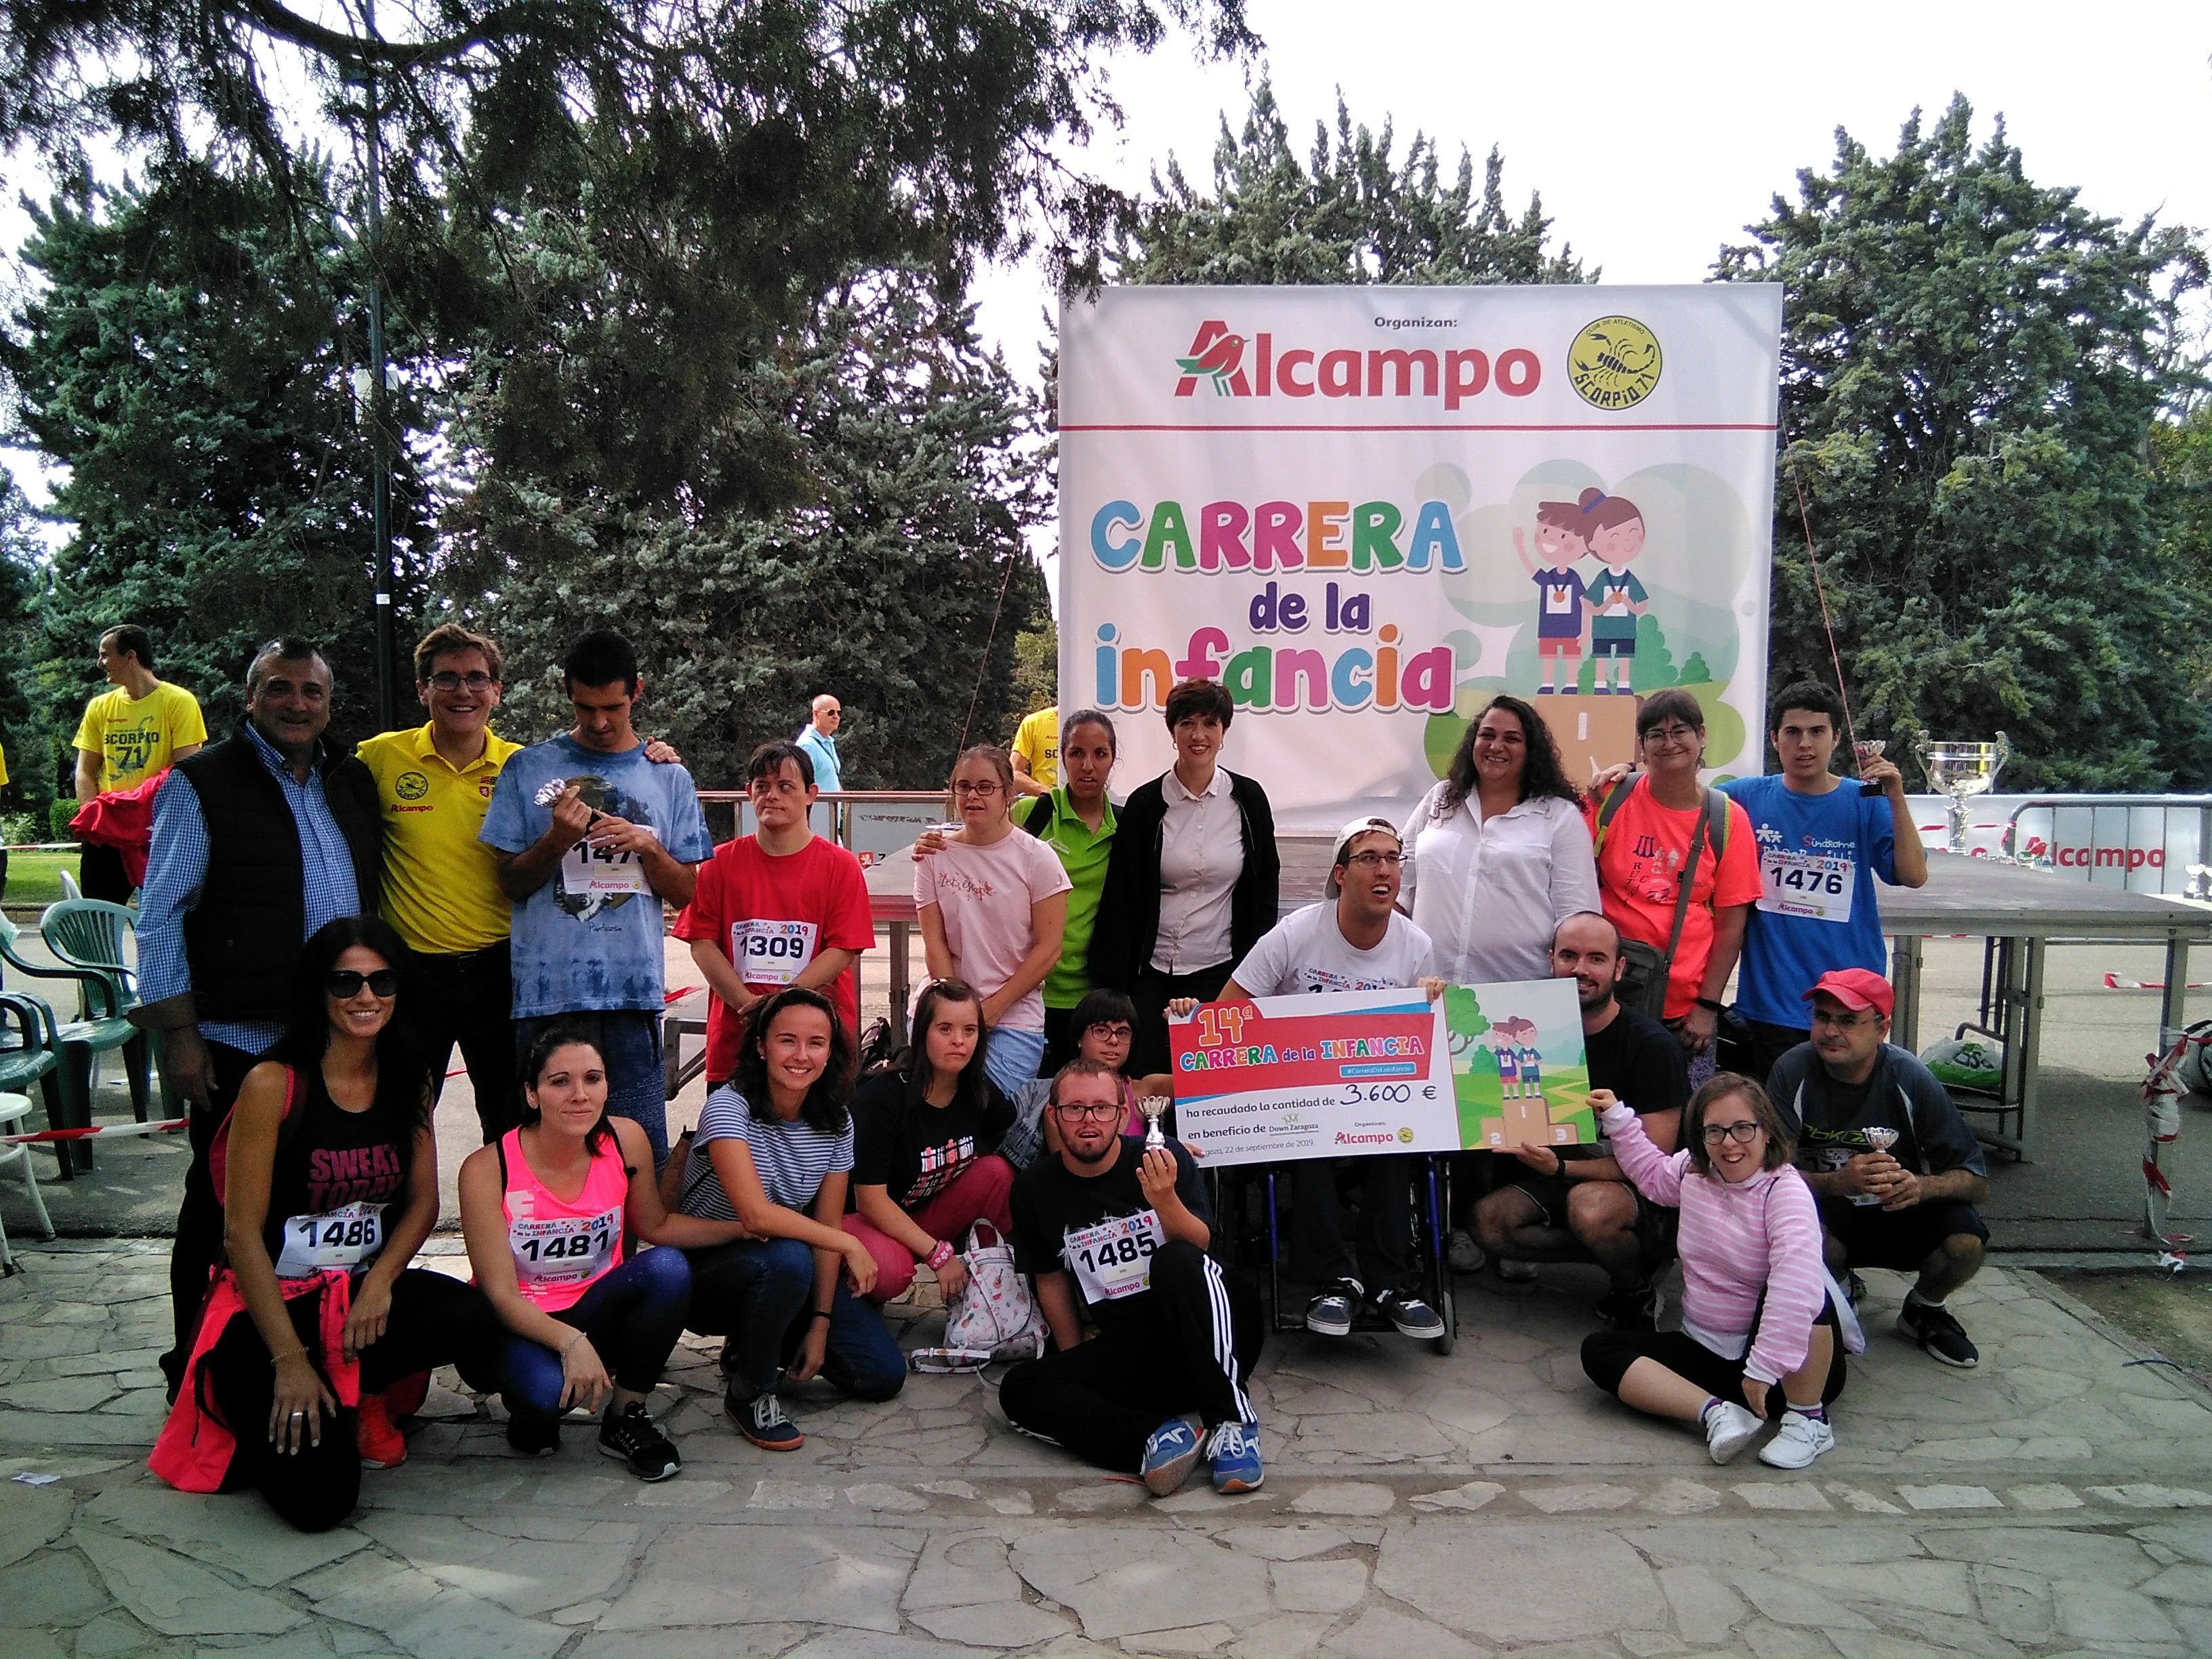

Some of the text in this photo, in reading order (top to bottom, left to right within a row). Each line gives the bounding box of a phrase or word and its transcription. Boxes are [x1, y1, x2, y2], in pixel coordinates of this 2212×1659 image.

[1374, 316, 1458, 330] Organizan:
[1585, 323, 1601, 335] CLUB
[1613, 319, 1645, 335] ATLETISMO
[1174, 320, 1542, 411] Alcampo
[1090, 499, 1467, 574] CARRERA
[1248, 580, 1373, 633] de la
[1093, 622, 1457, 714] infancia
[115, 746, 144, 769] 71
[390, 804, 434, 814] Alcampo
[2024, 836, 2167, 873] Alcampo
[1816, 859, 1847, 872] 2019
[589, 880, 630, 890] Alcampo
[1769, 866, 1843, 895] 1476
[1778, 903, 1814, 915] Alcampo
[779, 924, 808, 936] 2019
[739, 935, 804, 959] 1309
[1309, 968, 1338, 980] CARRERA
[1317, 976, 1351, 989] INFANCIA
[1180, 1036, 1425, 1071] CARRERA de la INFANCIA
[1340, 1084, 1411, 1105] 3.600
[1422, 1086, 1437, 1100] €
[1186, 1097, 1335, 1118] ha recaudado la cantidad de
[1187, 1124, 1266, 1140] en beneficio de
[1290, 1123, 1319, 1132] Zaragoza
[1555, 1128, 1567, 1142] 3
[1334, 1132, 1394, 1145] Alcampo
[1490, 1132, 1502, 1145] 2
[1235, 1145, 1244, 1153] de
[1246, 1141, 1284, 1154] septiembre
[518, 1222, 557, 1230] CARRERA
[581, 1213, 614, 1232] 2019
[1120, 1215, 1153, 1234] 2019
[298, 1218, 375, 1248] 1486
[531, 1227, 575, 1237] INFANCIA
[1069, 1230, 1100, 1244] CARRERA
[1081, 1231, 1118, 1248] INFANCIA
[521, 1229, 609, 1262] 1481
[1079, 1231, 1158, 1273] 1485
[533, 1273, 578, 1283] Alcampo
[1104, 1282, 1141, 1296] Alcampo
